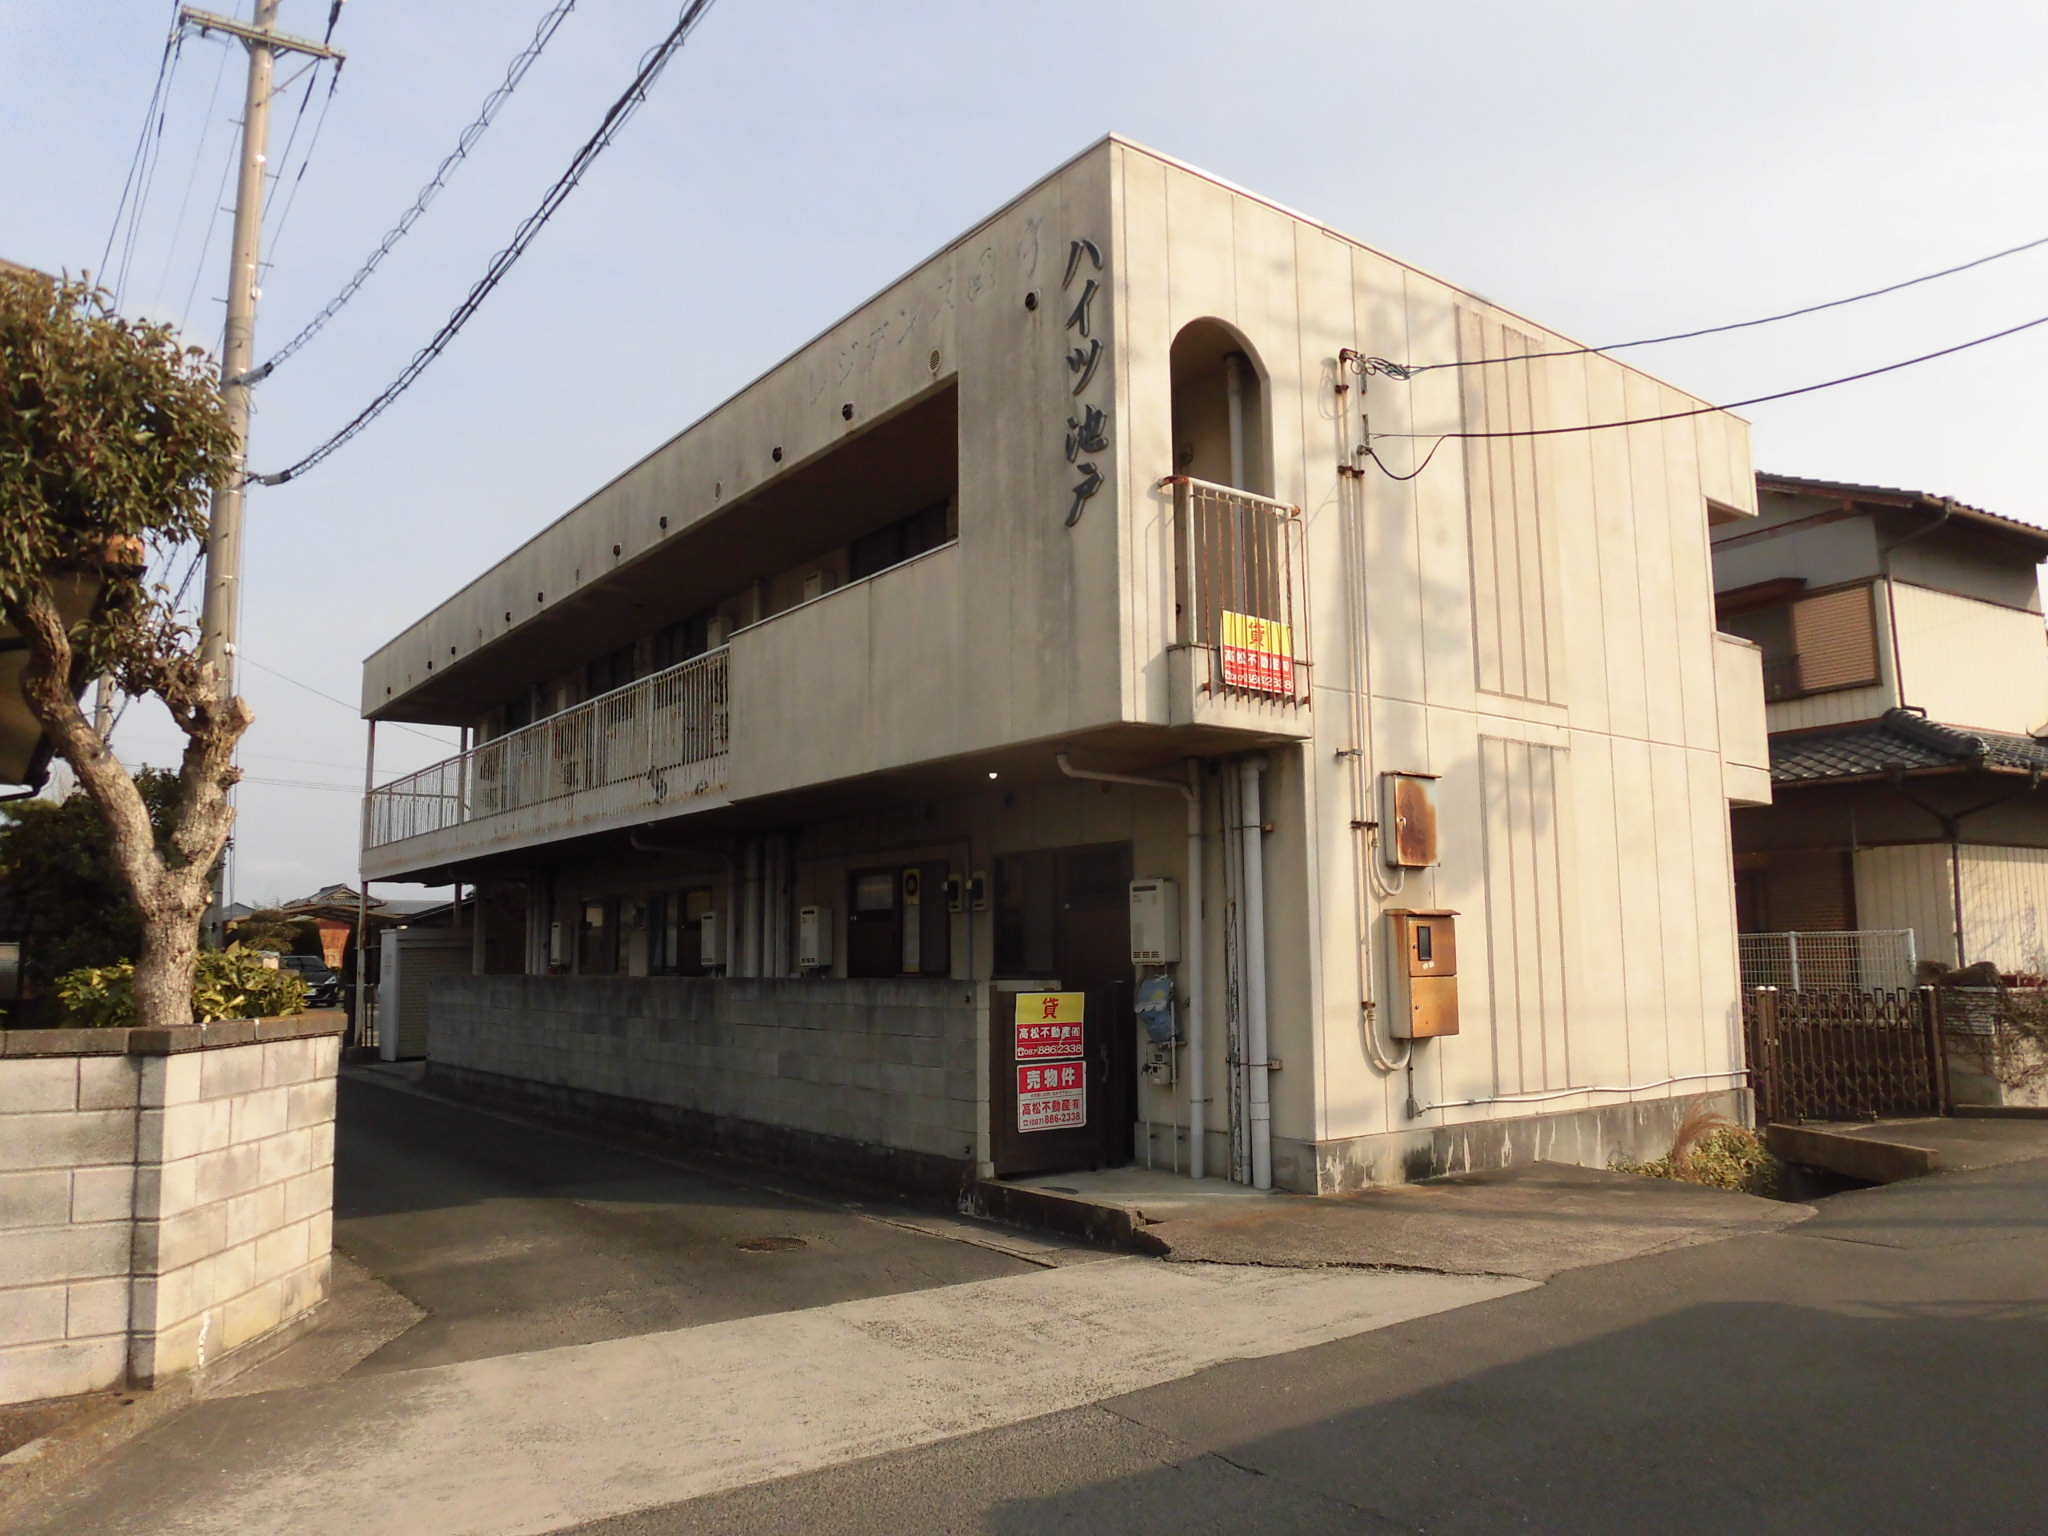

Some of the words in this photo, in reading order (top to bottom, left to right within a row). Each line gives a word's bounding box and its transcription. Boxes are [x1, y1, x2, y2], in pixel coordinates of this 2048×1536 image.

[1248, 622, 1265, 647] 貸
[1042, 997, 1059, 1019] 貸
[1026, 1067, 1076, 1089] 売物件
